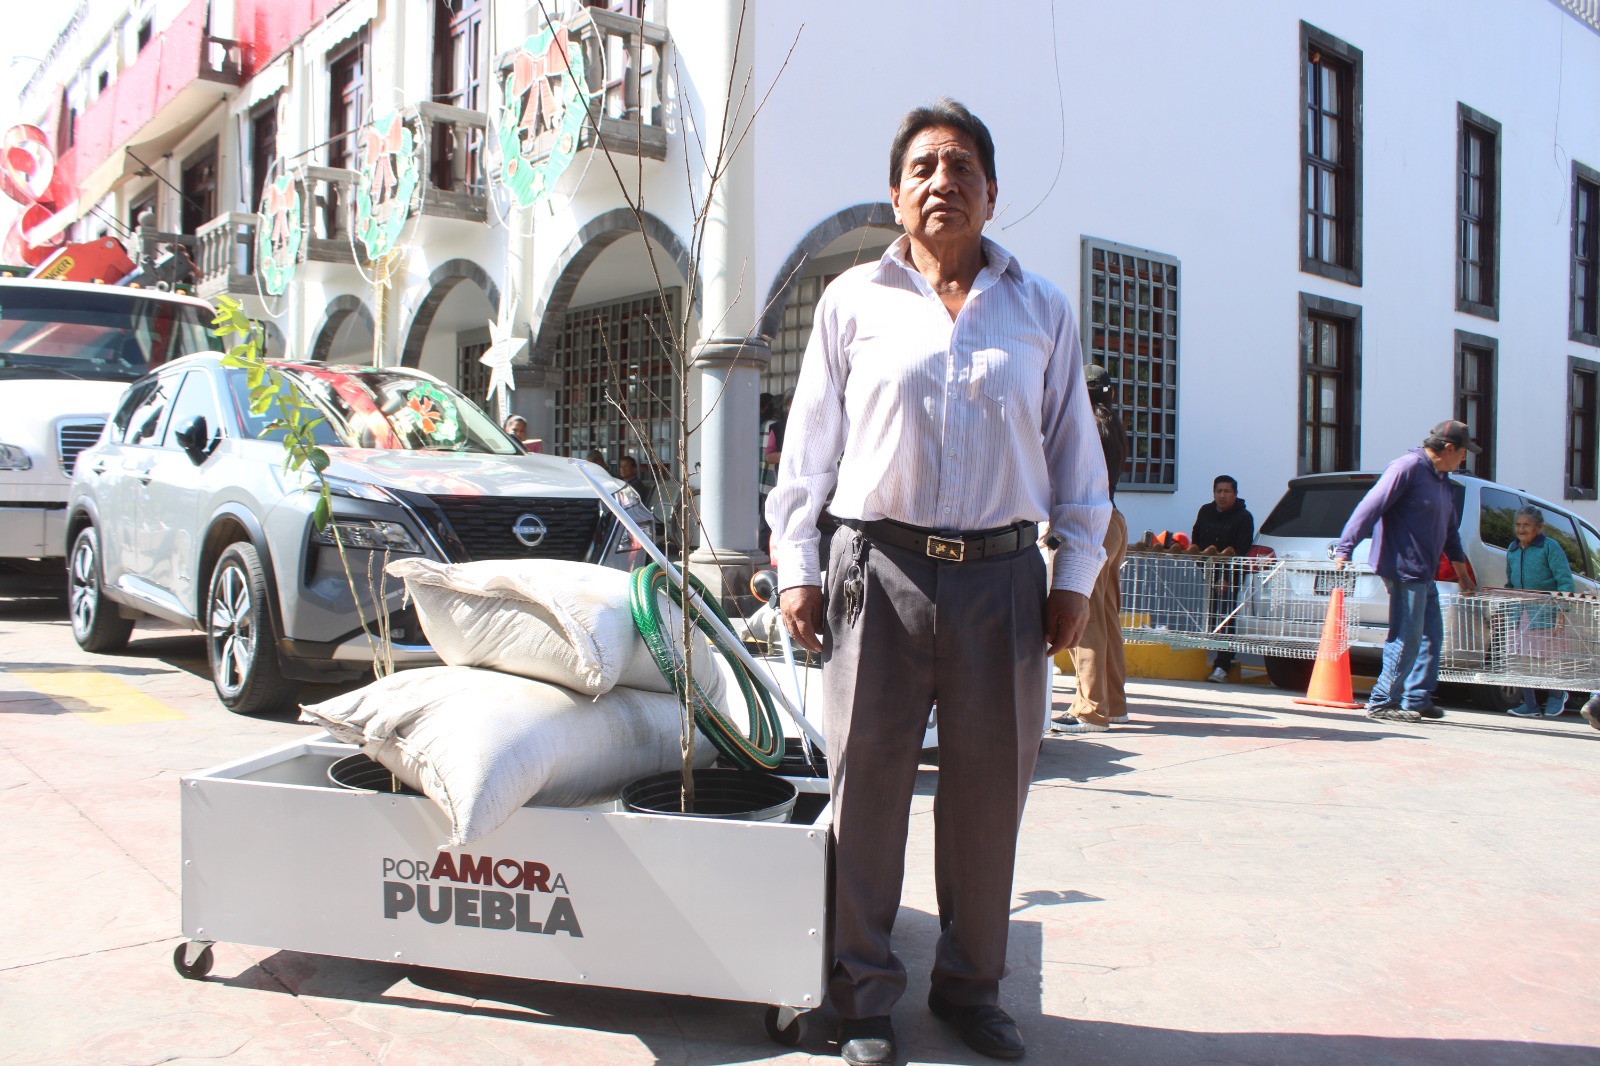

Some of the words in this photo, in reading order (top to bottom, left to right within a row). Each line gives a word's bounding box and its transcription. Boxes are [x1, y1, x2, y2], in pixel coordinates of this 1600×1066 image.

[512, 525, 547, 534] NISSAN
[383, 857, 430, 881] POR
[430, 851, 551, 893] AMOR
[550, 873, 570, 895] A
[383, 881, 584, 938] PUEBLA
